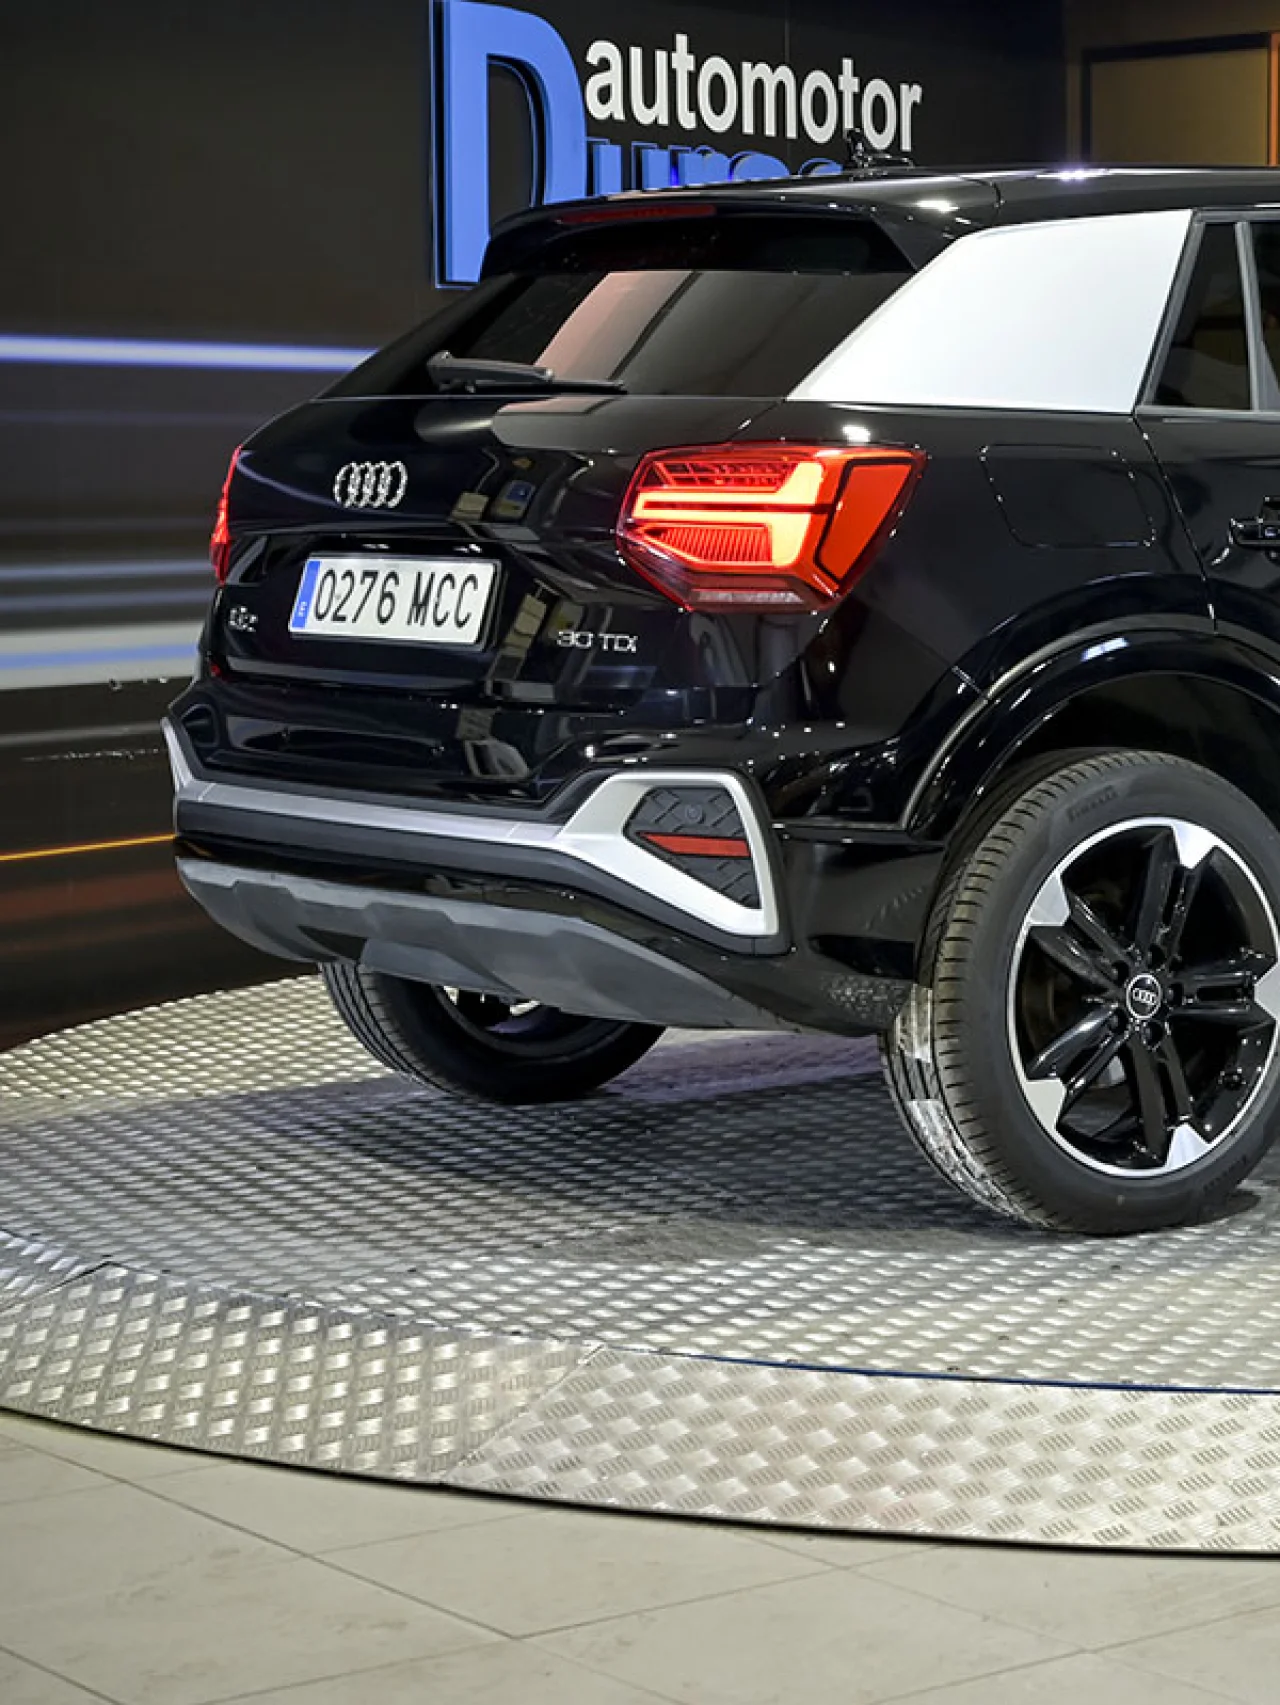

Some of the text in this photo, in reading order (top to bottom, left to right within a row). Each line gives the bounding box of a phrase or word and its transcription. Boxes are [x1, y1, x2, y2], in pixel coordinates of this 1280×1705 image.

[585, 33, 922, 152] automotor
[314, 568, 479, 628] 0276 MCC
[556, 631, 593, 649] 30
